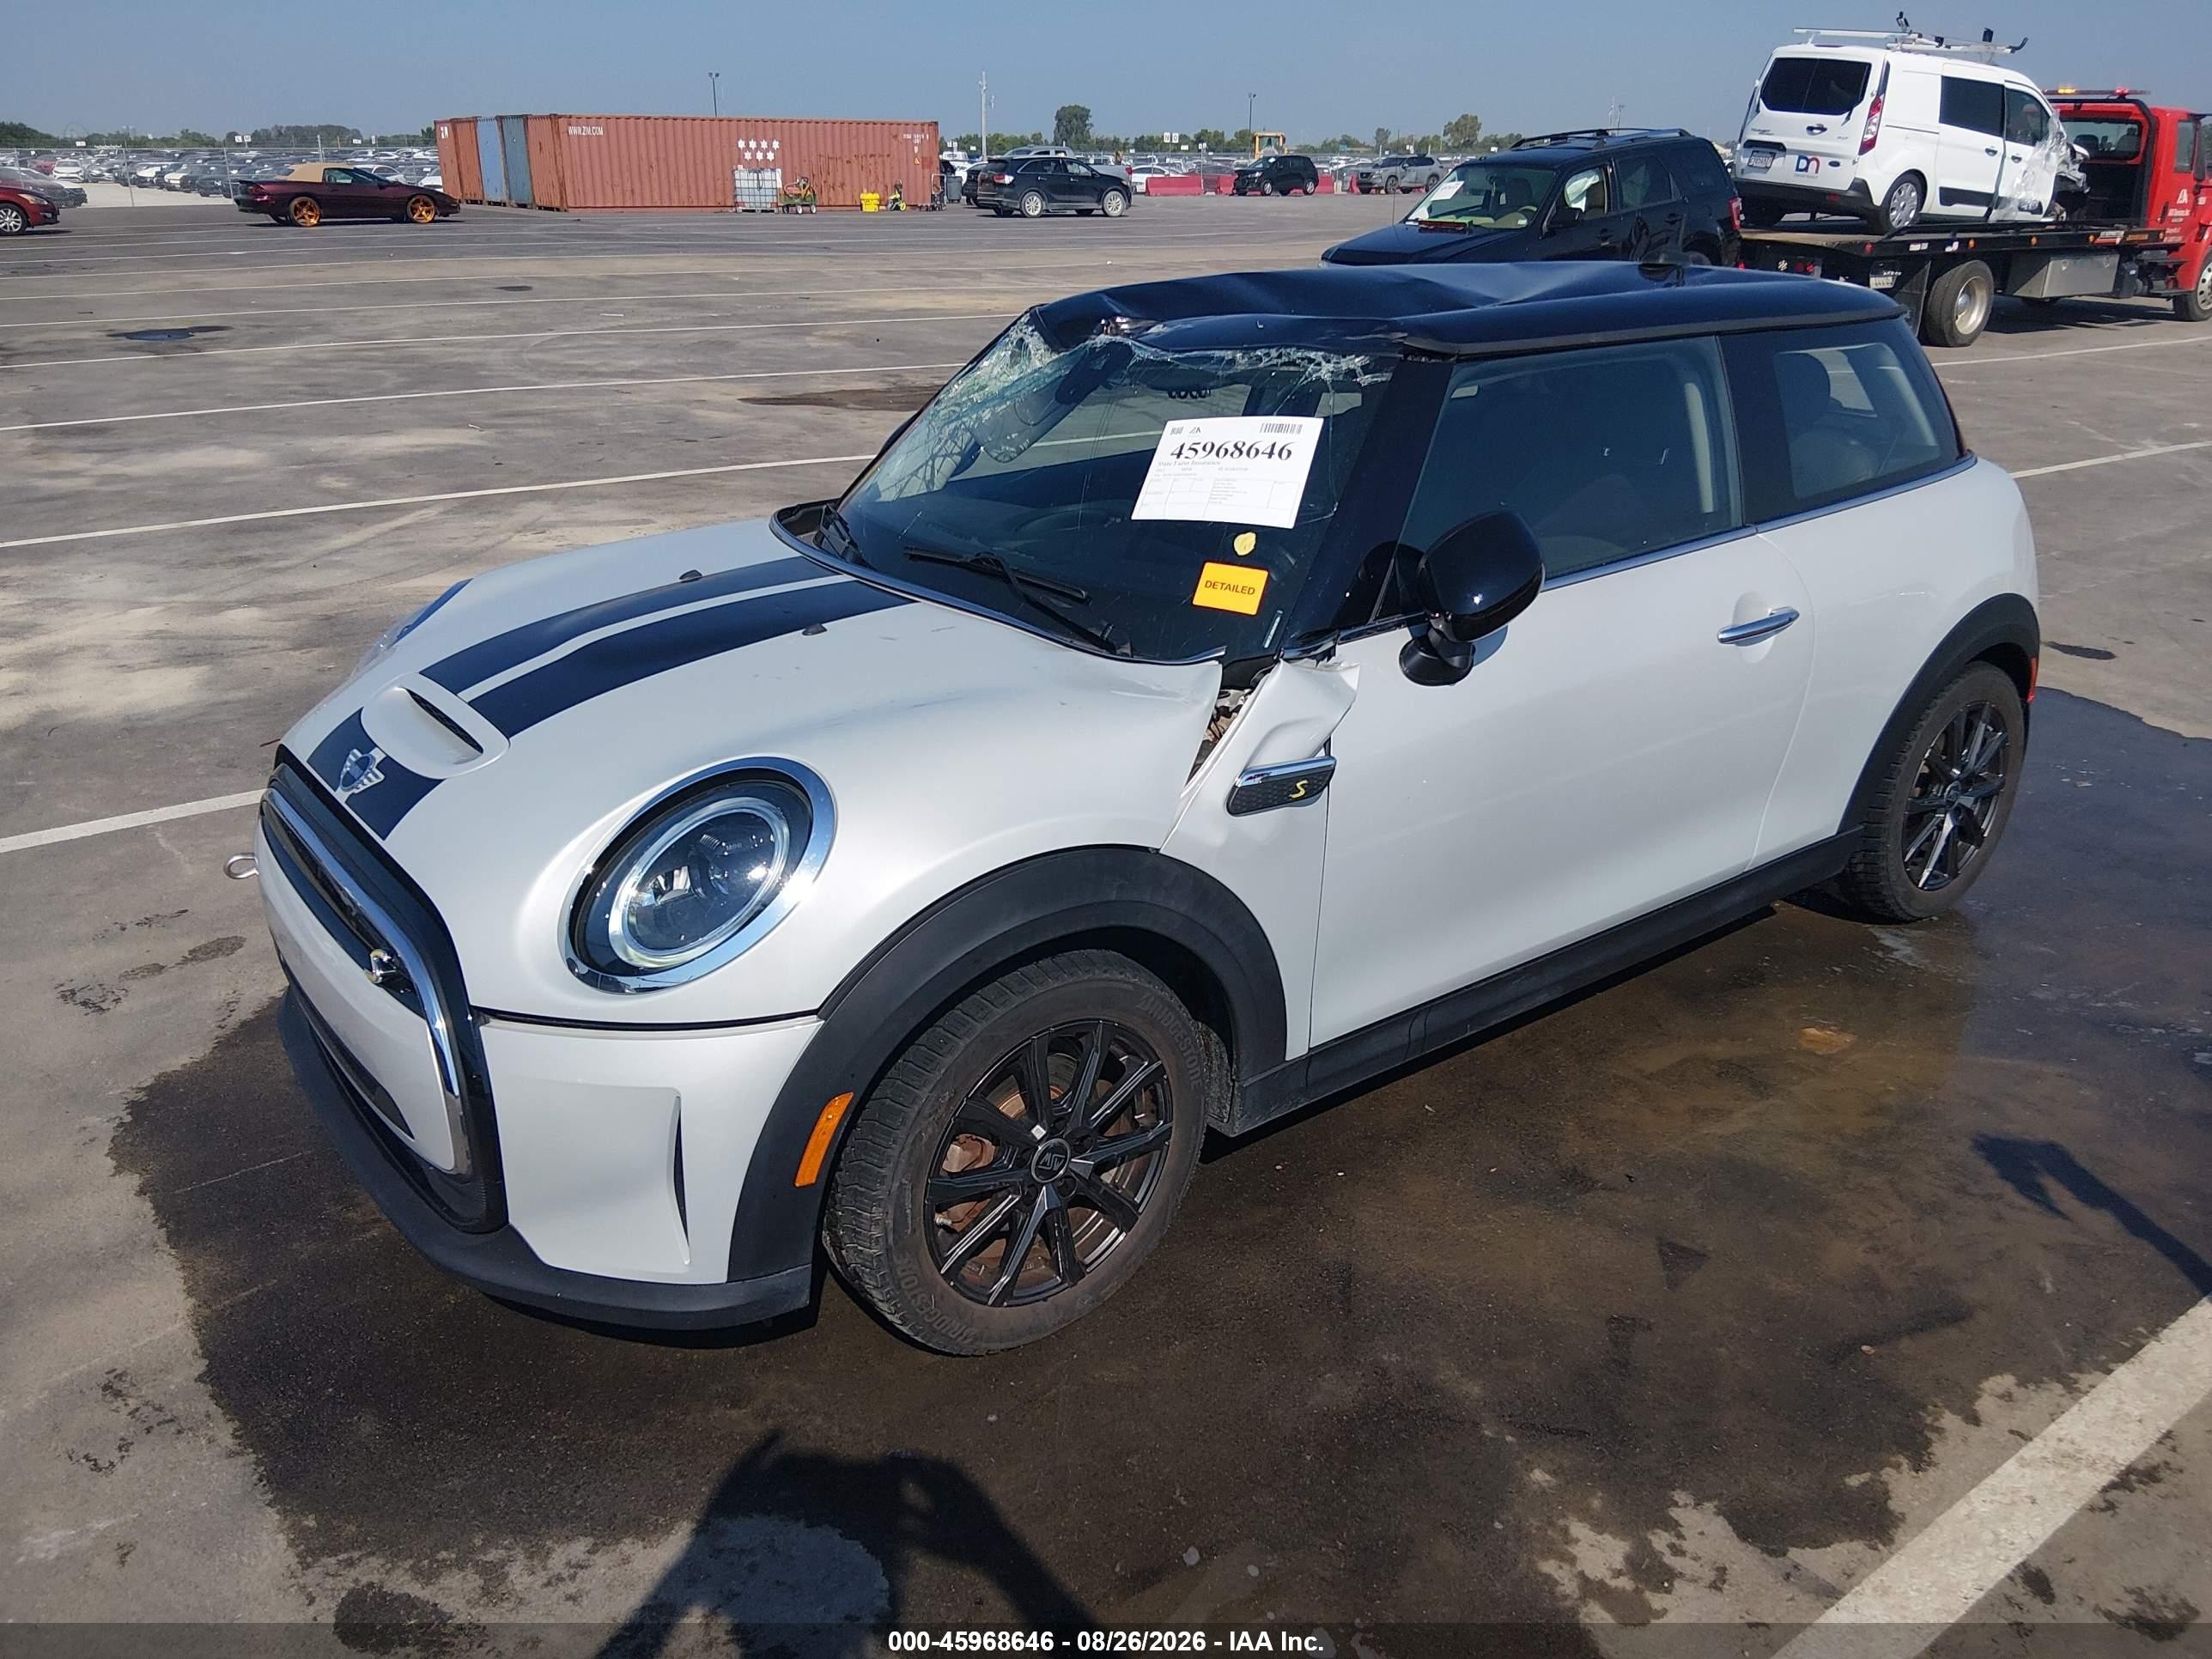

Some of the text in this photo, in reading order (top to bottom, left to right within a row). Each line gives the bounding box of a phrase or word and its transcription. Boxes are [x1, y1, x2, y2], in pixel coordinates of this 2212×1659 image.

[1170, 441, 1296, 461] 45968646
[1204, 580, 1256, 596] DETAILED
[1290, 779, 1310, 799] S
